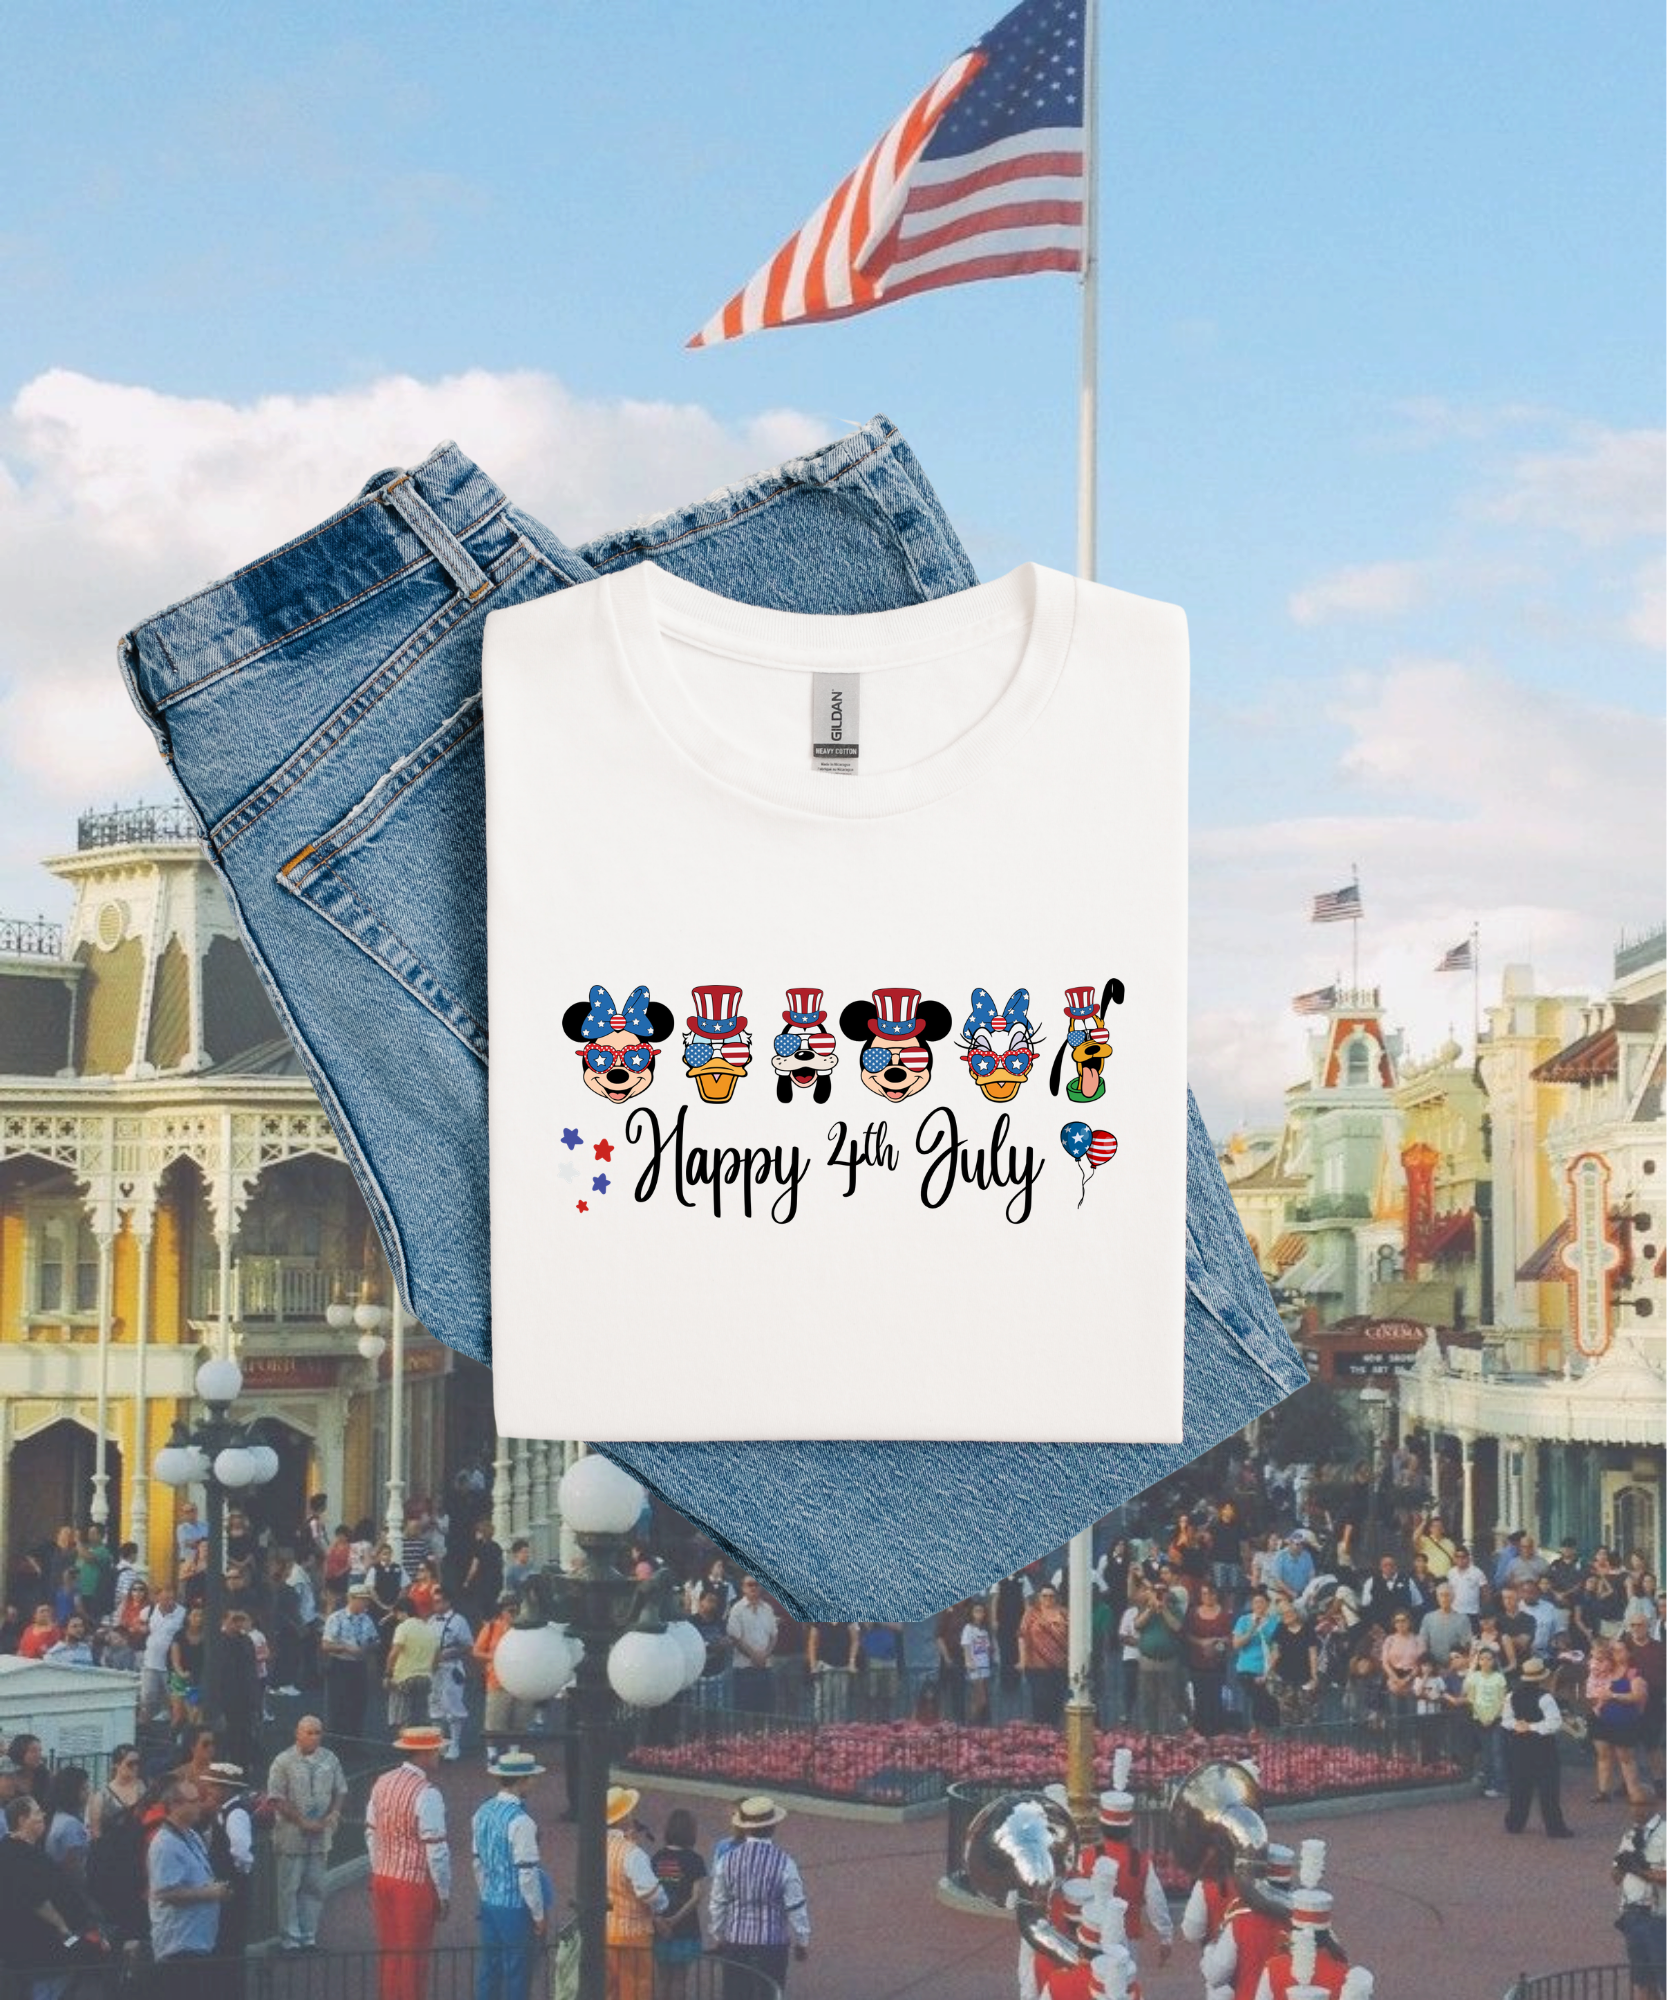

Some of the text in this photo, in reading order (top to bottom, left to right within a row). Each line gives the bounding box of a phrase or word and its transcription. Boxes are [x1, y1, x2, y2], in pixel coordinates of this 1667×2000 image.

[831, 691, 843, 742] GILDAN
[815, 747, 857, 755] HEAVY COTTON
[625, 1104, 1046, 1225] Happy 4th July
[1365, 1327, 1424, 1340] CINEMA
